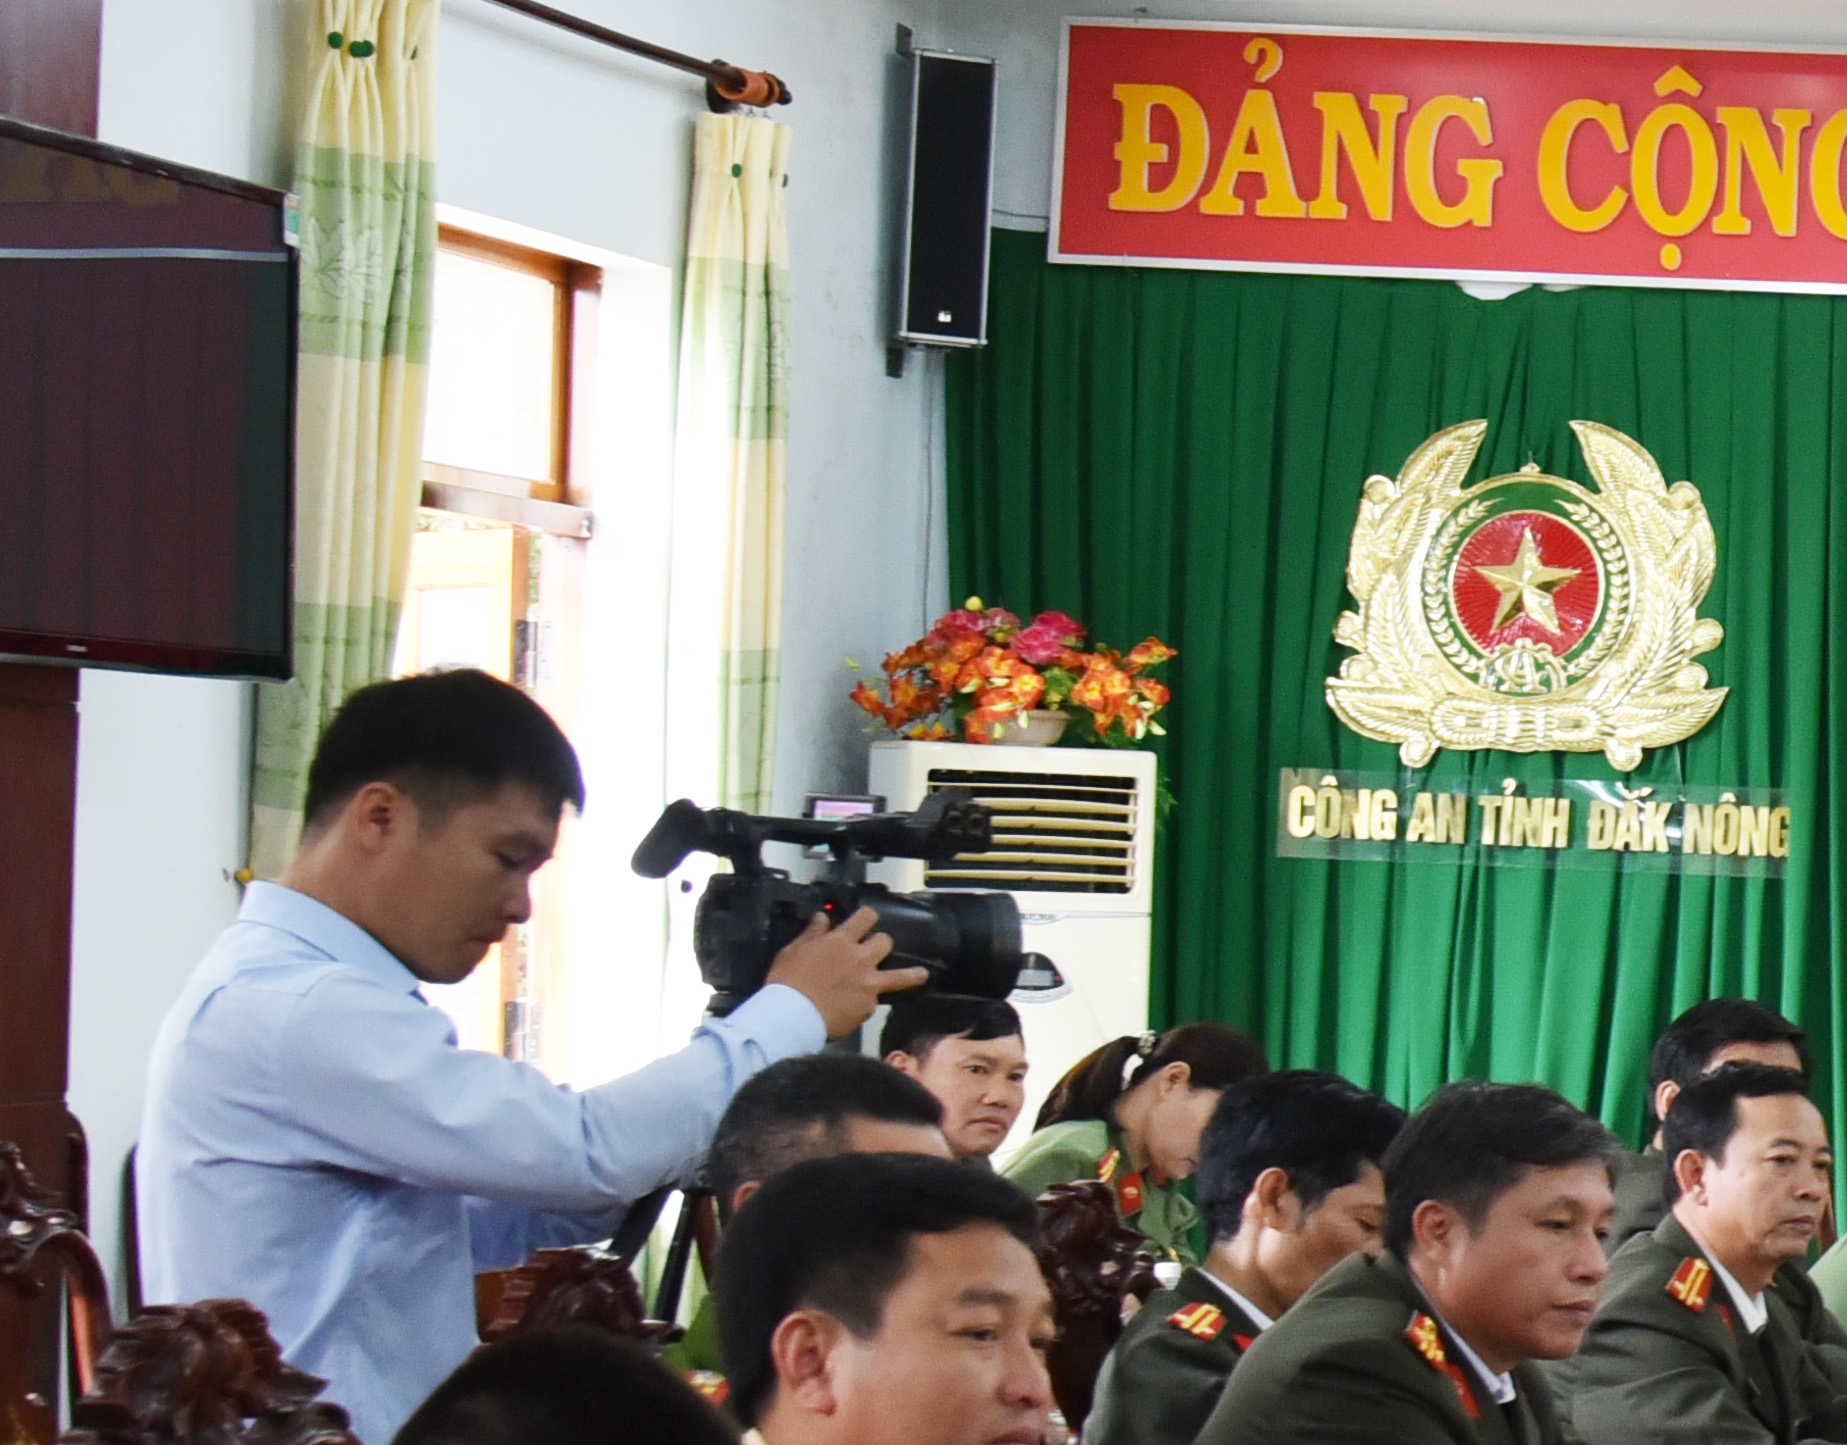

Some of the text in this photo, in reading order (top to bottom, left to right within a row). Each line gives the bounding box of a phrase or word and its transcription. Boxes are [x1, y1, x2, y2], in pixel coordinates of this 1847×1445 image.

[1109, 39, 1502, 229] ĐẢNG
[1286, 773, 1790, 858] CÔNG AN TỈNH ĐẮK NÔNG
